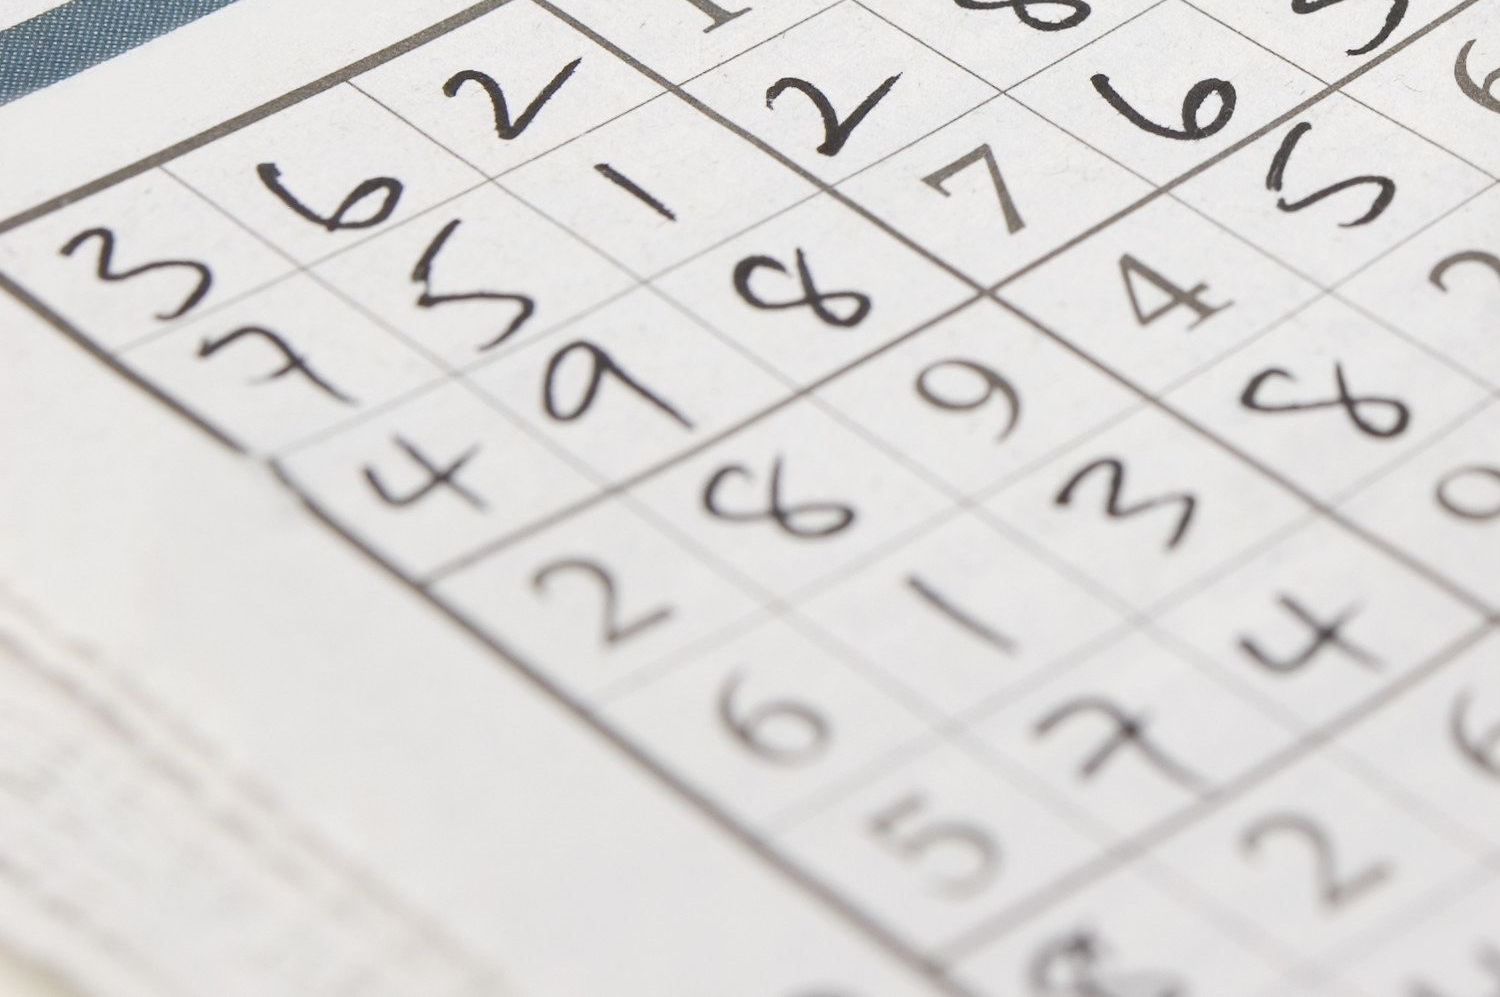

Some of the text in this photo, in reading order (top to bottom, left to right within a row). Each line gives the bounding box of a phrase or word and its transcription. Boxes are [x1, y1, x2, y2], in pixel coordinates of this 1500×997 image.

[443, 57, 582, 139] 2
[766, 72, 904, 156] 2
[1089, 73, 1237, 141] 6
[256, 162, 404, 232] 6
[594, 163, 677, 221] 1
[920, 142, 1026, 236] 7
[1265, 122, 1397, 228] 5
[60, 228, 212, 320] 3
[412, 218, 535, 351] 5
[733, 249, 871, 328] 8
[1116, 251, 1235, 333] 4
[197, 326, 358, 404] 7
[542, 340, 695, 430] 9
[913, 359, 1022, 442] 9
[1240, 361, 1411, 438] 8
[361, 435, 492, 511] 4
[702, 455, 857, 536] 8
[1054, 459, 1197, 552] 3
[530, 558, 676, 645] 2
[905, 574, 1020, 655] 1
[1238, 593, 1387, 675] 4
[713, 671, 834, 770] 6
[1030, 696, 1217, 790] 7
[866, 793, 1006, 903] 5
[1239, 811, 1395, 914] 2
